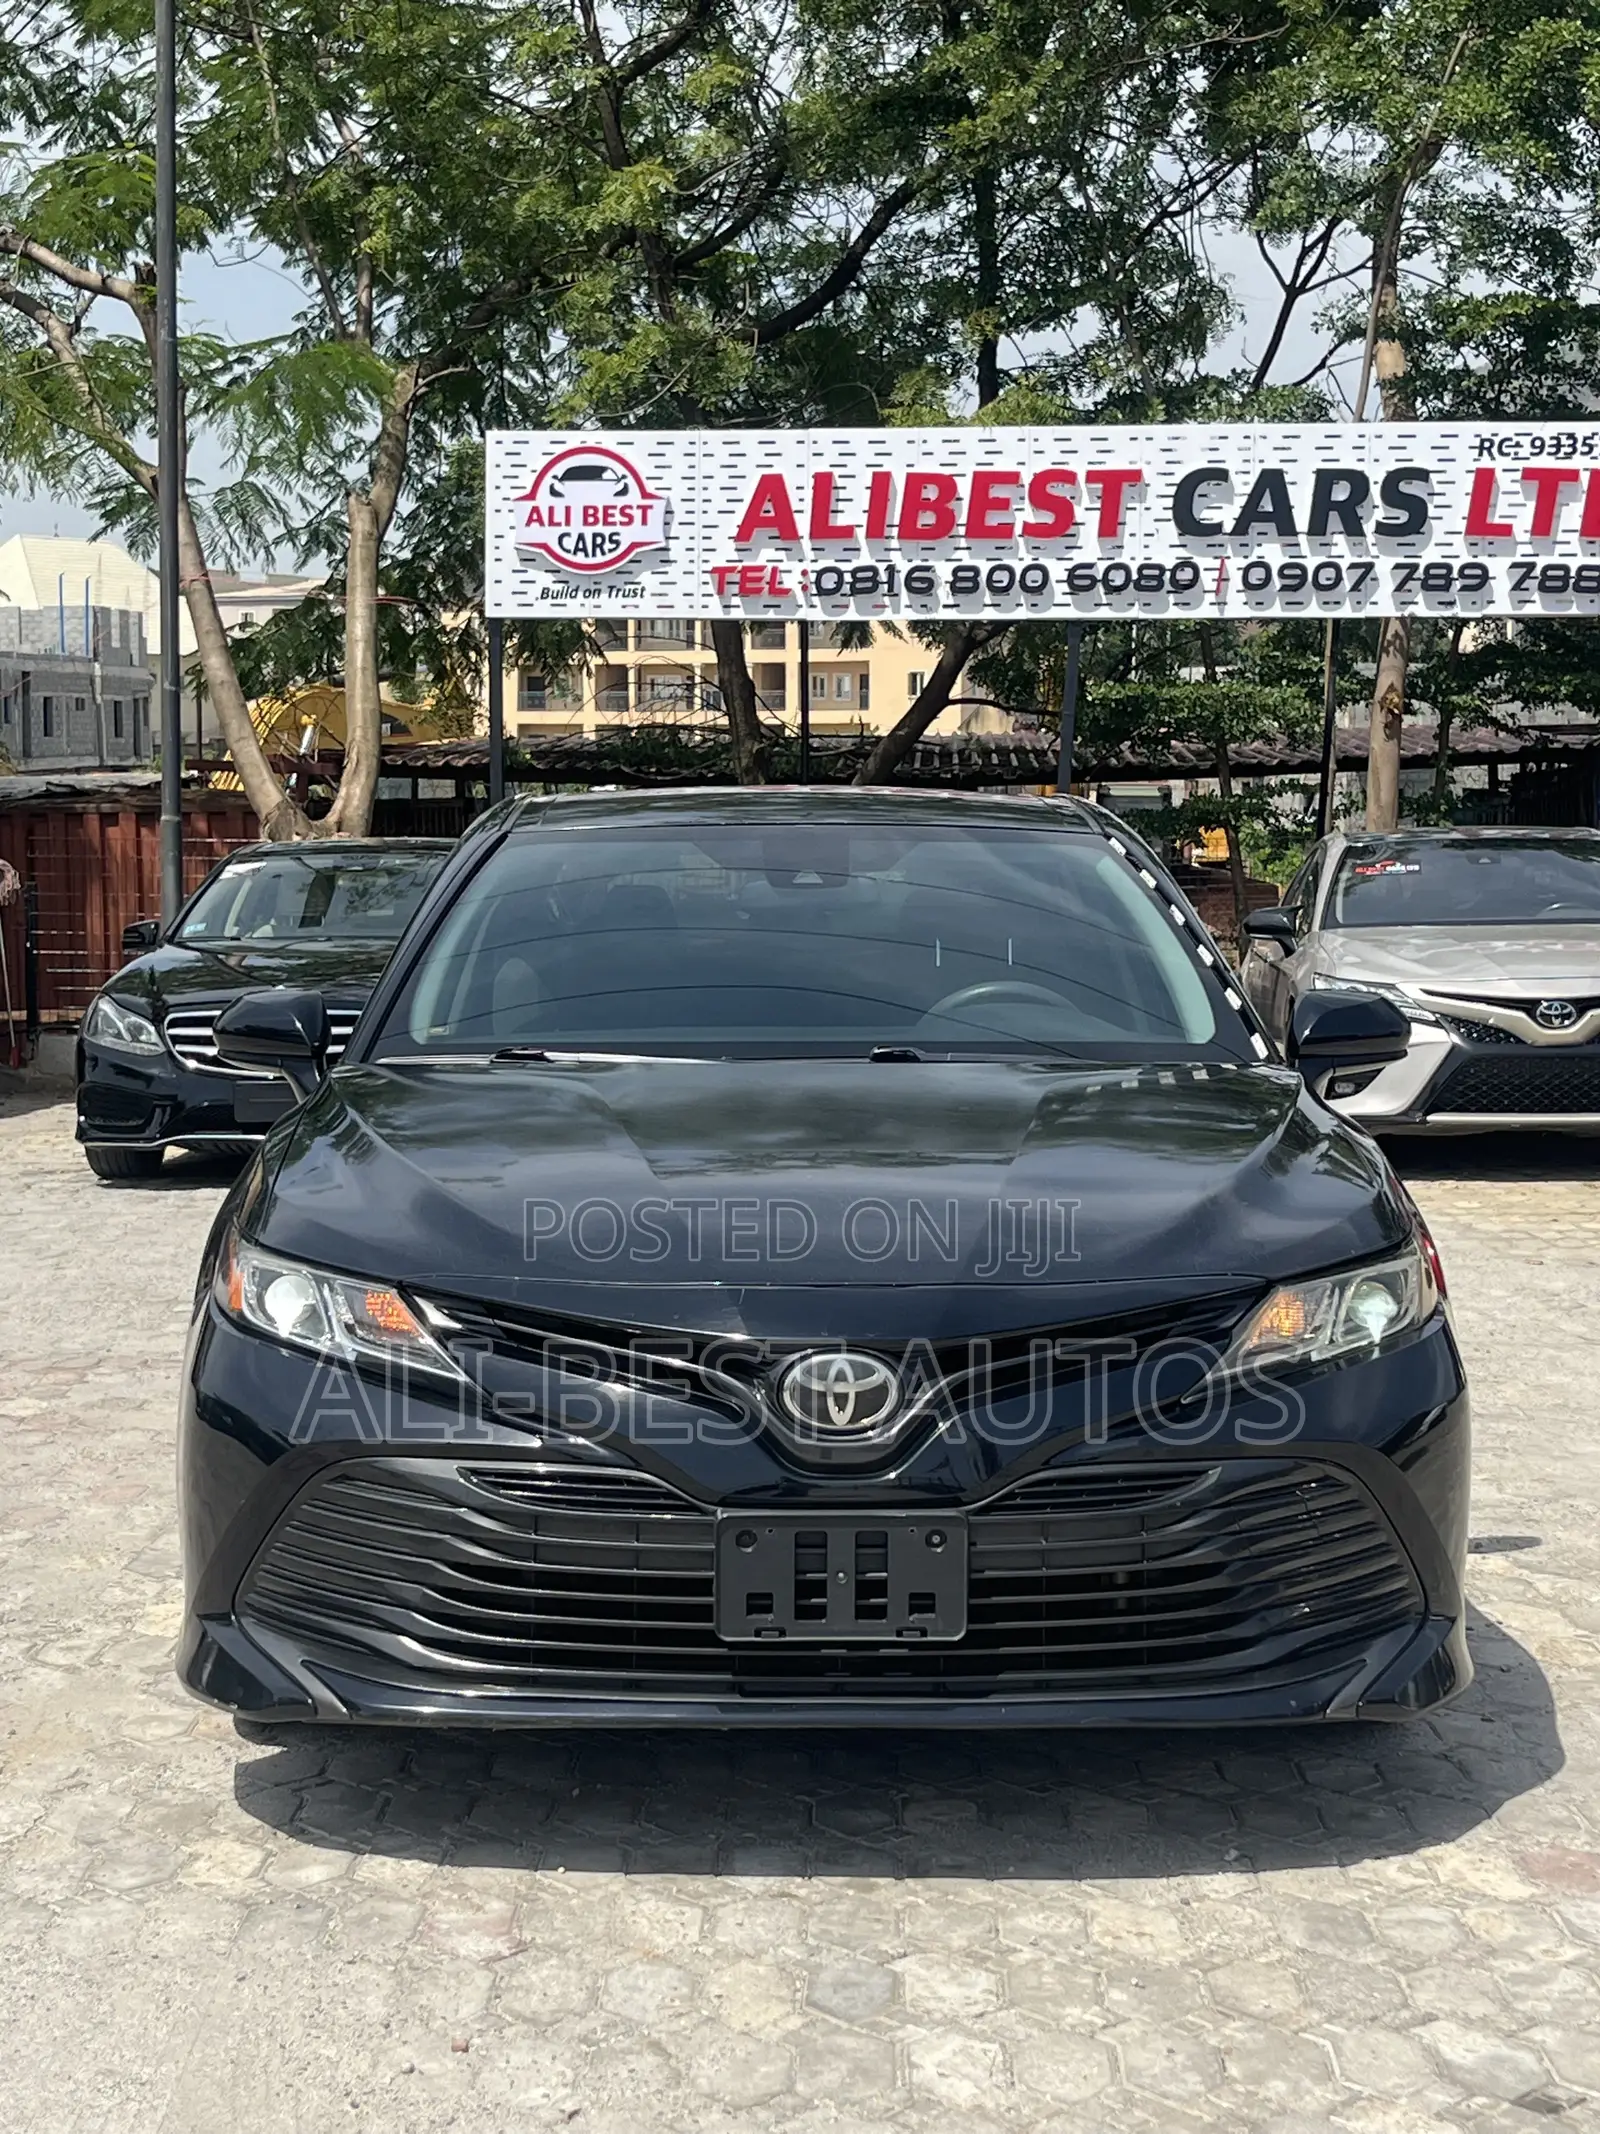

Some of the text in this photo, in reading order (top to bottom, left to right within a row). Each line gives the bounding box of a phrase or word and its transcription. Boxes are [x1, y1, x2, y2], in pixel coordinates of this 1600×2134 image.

[525, 504, 654, 527] ALI BEST
[735, 469, 1142, 542] ALIBEST
[1172, 467, 1430, 538] CARS
[557, 531, 622, 558] CARS
[814, 563, 935, 596] 0816
[950, 562, 1050, 596] 800
[1066, 561, 1200, 593] 6080
[1241, 560, 1375, 593] 0907
[1392, 561, 1490, 593] 789
[540, 585, 646, 600] Build on Trust
